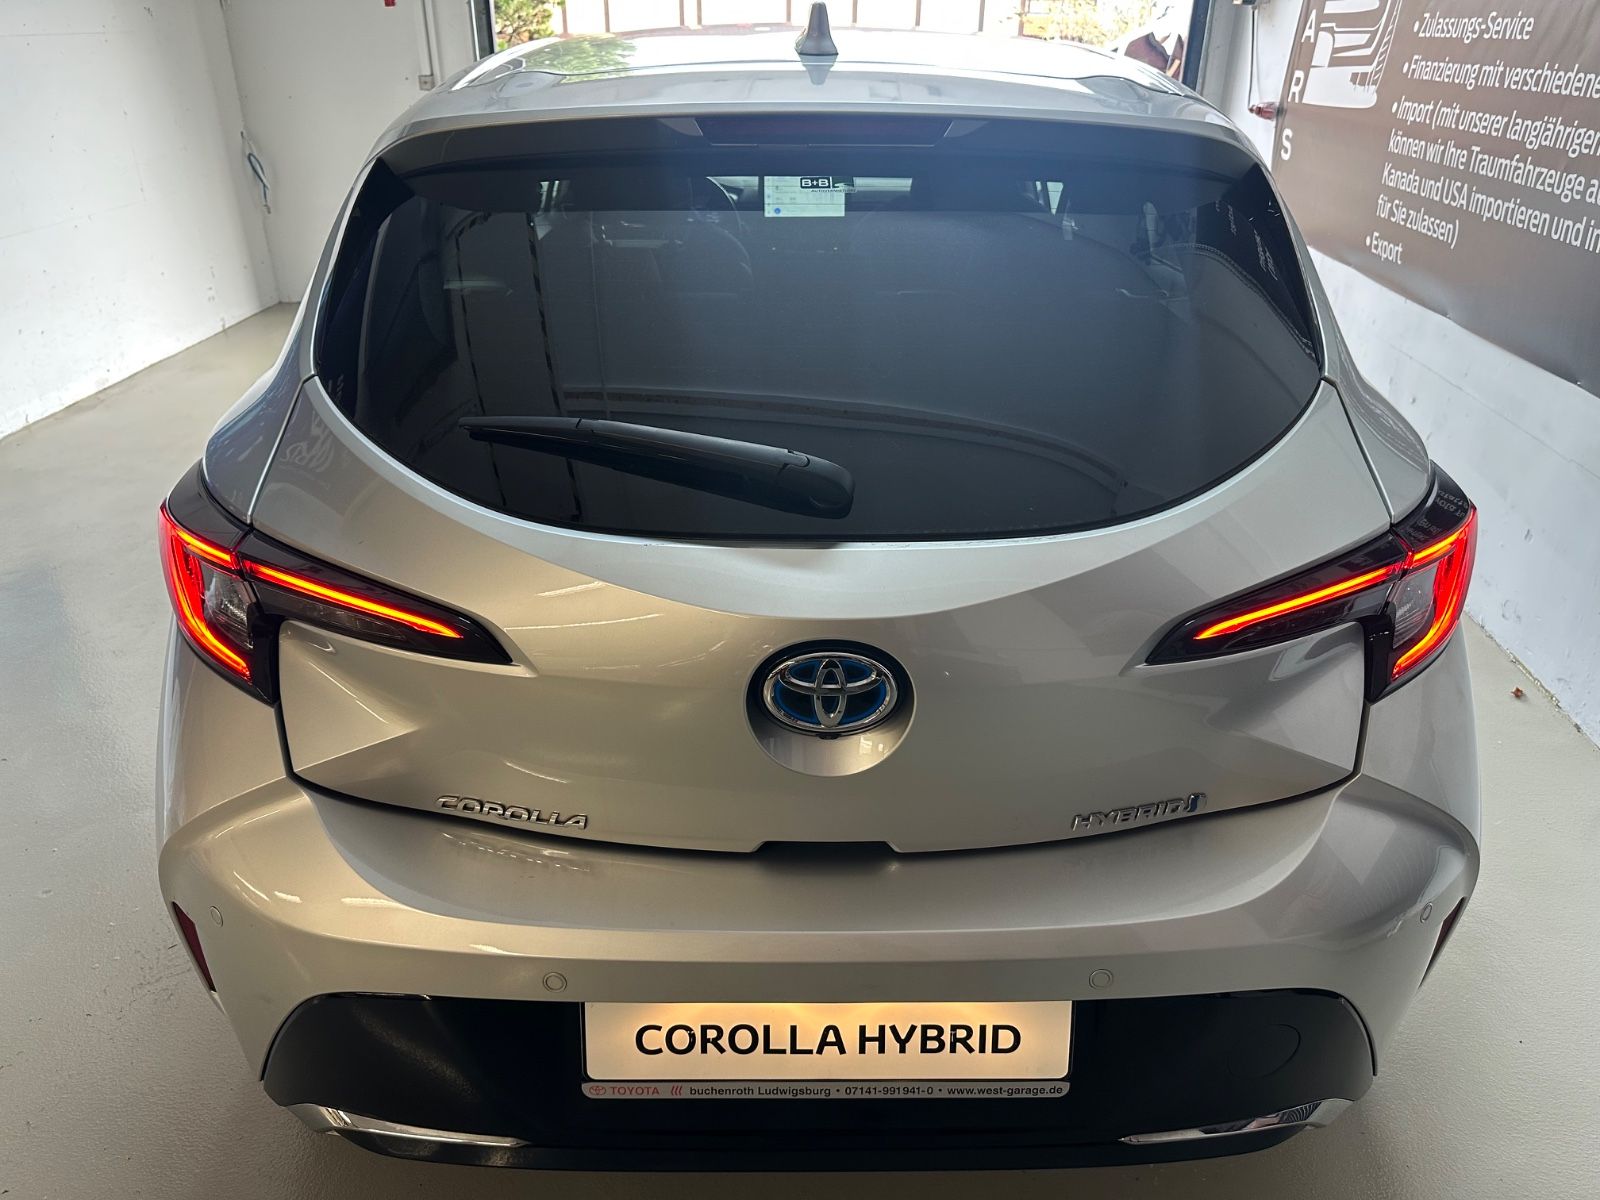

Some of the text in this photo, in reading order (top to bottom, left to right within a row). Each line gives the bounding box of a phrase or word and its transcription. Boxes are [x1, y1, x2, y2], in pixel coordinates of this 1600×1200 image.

[1418, 11, 1535, 44] Zulassungs-Service
[1408, 55, 1480, 91] Finanzierung
[1477, 60, 1504, 88] mit
[1397, 95, 1434, 125] Import
[1431, 100, 1460, 130] (mit
[1458, 107, 1508, 138] unserer
[801, 178, 829, 187] B+B
[1387, 128, 1600, 206] können wir Ihre Traumfahrzeuge a
[1381, 162, 1419, 194] Kanada
[1420, 176, 1444, 201] und
[1442, 178, 1469, 210] USA
[1468, 186, 1550, 237] importieren
[1550, 216, 1587, 247] und
[1376, 194, 1459, 250] für Sie zulassen)
[1371, 231, 1403, 264] Export
[435, 795, 588, 830] COROLLA
[1071, 797, 1185, 831] HYBRID
[634, 1023, 1022, 1056] COROLLA HYBRID
[609, 1086, 660, 1096] TOYOTA
[689, 1085, 754, 1096] buchenroth
[757, 1085, 831, 1098] Ludwigsburg
[947, 1085, 1063, 1098] www.west-garage.de
